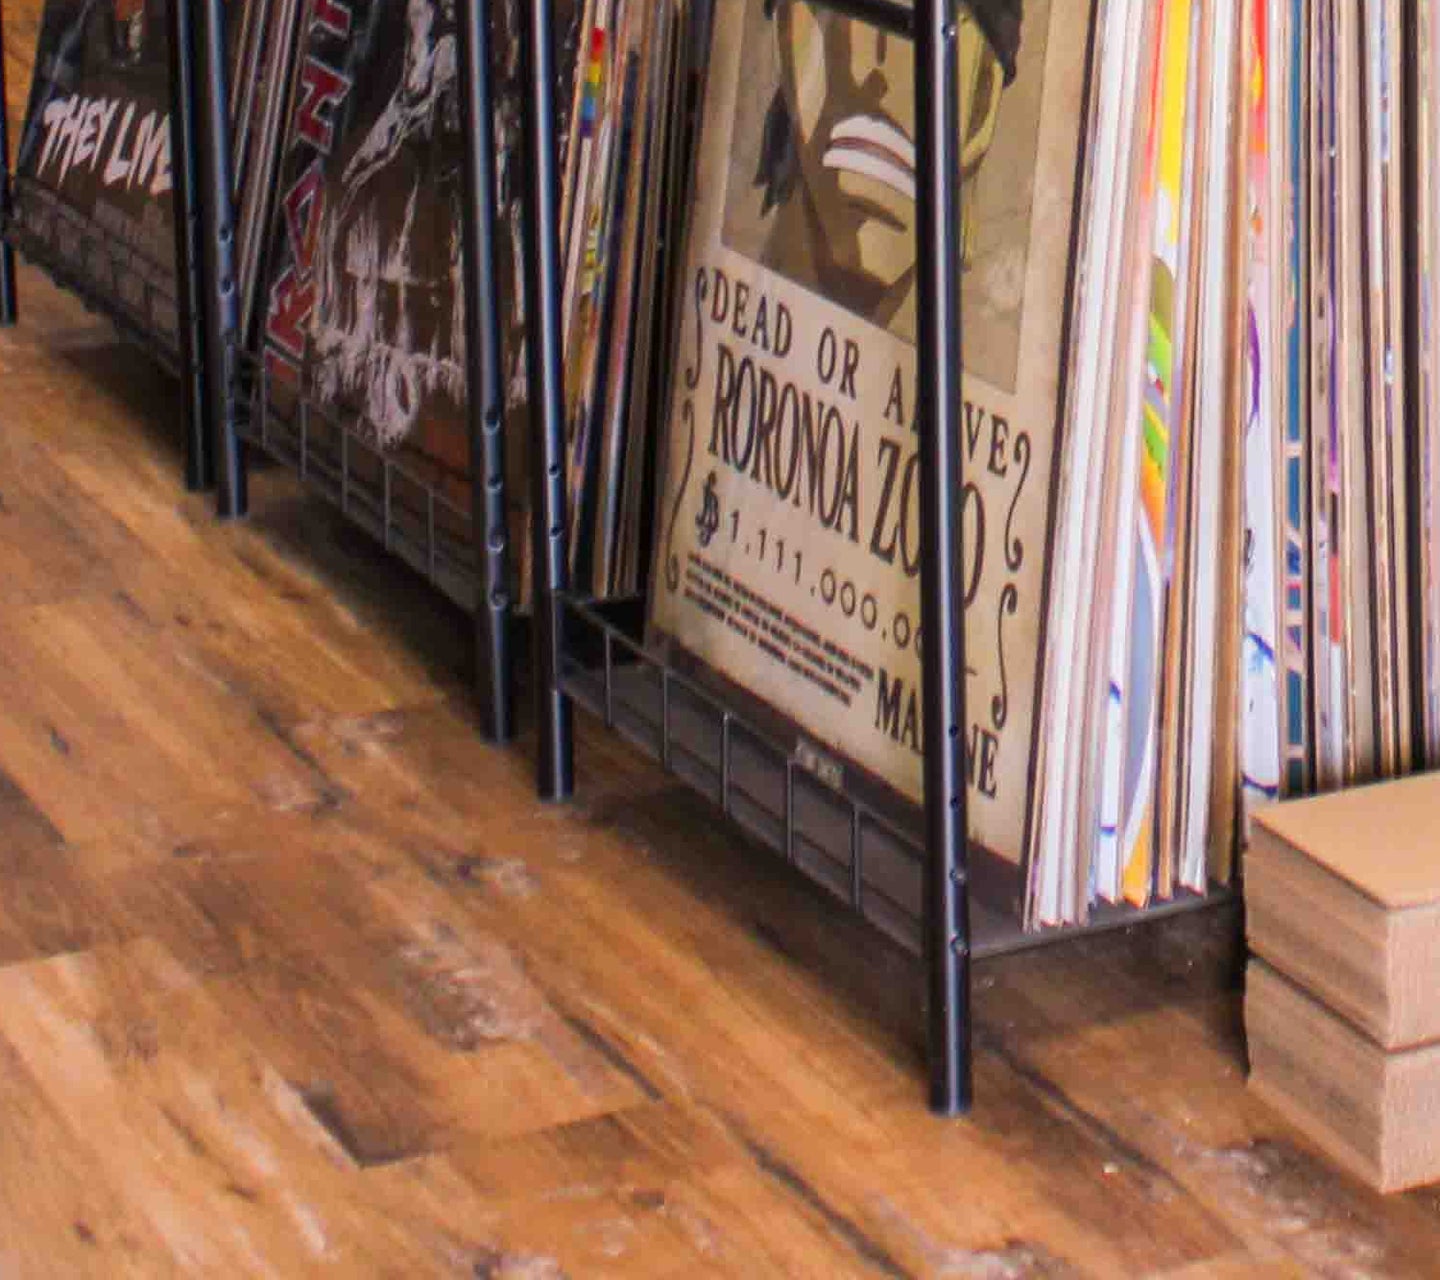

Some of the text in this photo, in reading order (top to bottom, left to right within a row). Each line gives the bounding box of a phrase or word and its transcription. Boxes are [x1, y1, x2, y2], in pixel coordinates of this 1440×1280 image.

[41, 96, 113, 180] THEY
[265, 59, 350, 390] IRON
[708, 342, 988, 612] RORONOA ZOO
[710, 267, 1010, 480] DEAD OR AVE
[873, 668, 1000, 800] MANE
